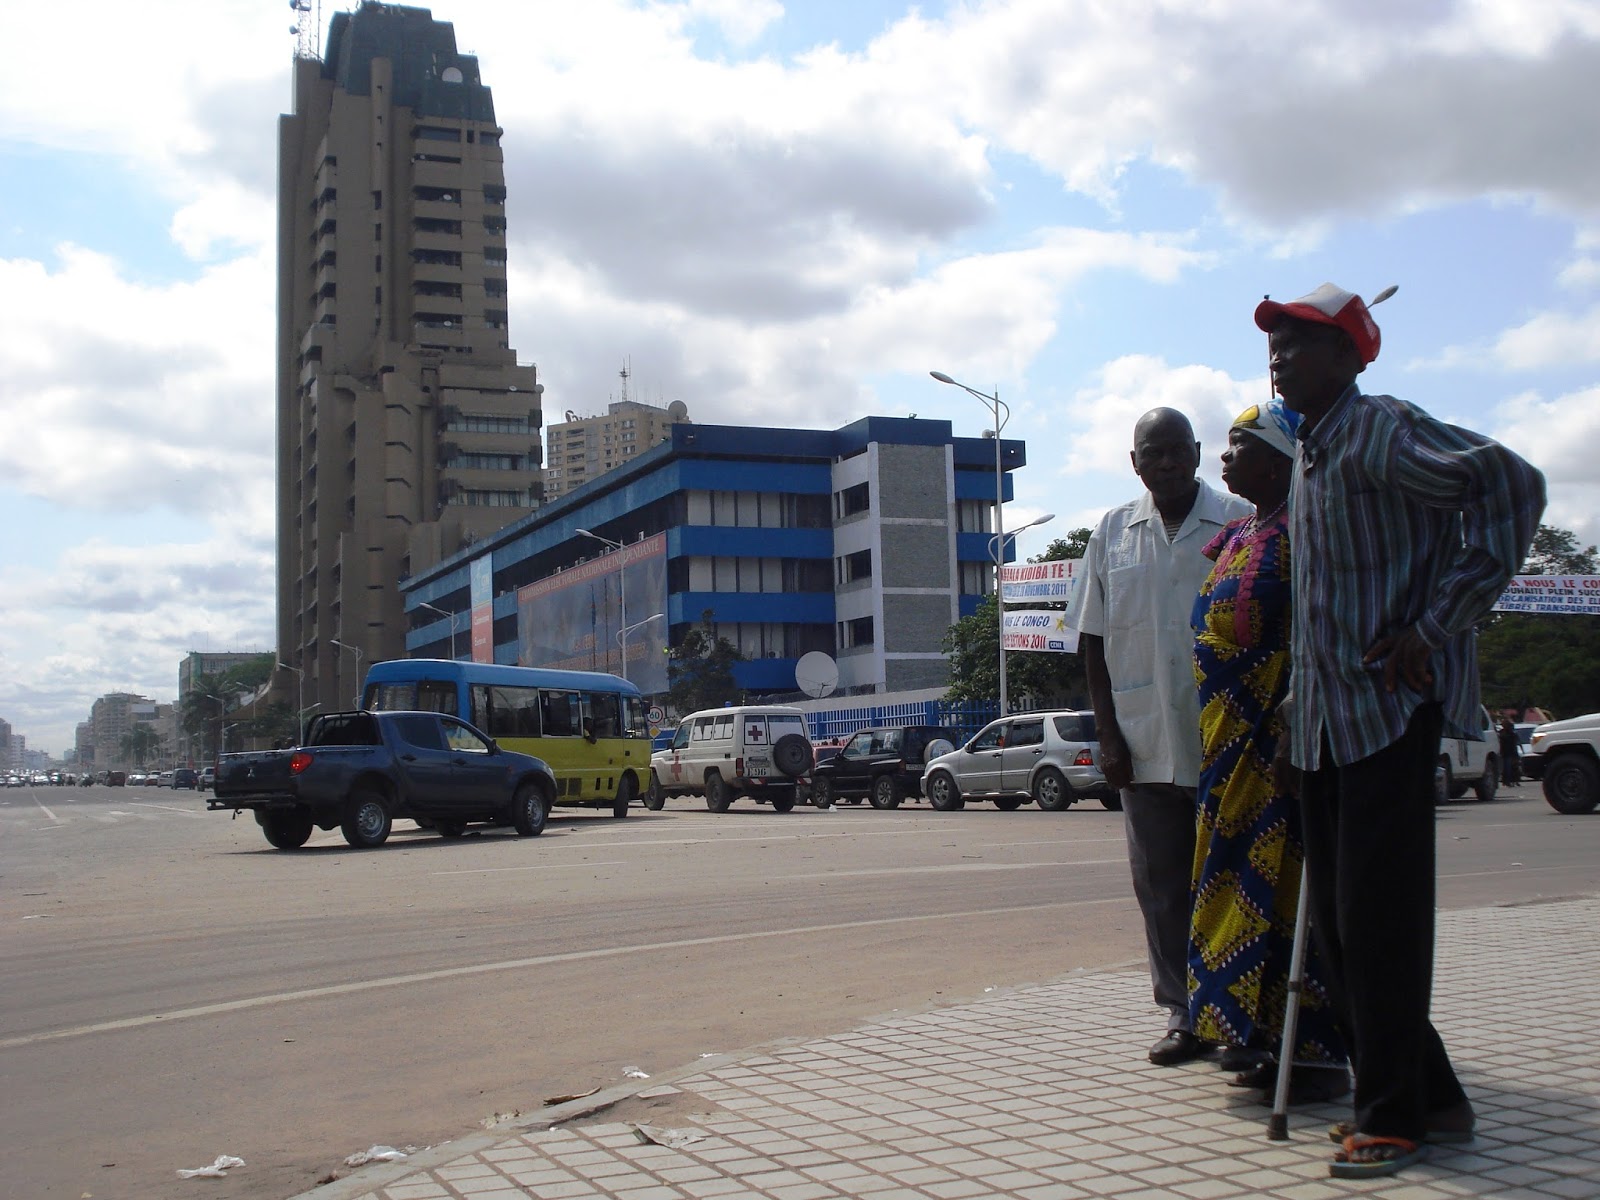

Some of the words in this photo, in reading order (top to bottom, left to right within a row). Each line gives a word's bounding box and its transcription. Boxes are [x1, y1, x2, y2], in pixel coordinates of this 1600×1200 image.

[1052, 564, 1064, 578] TE
[1523, 580, 1556, 588] NOUS
[1563, 580, 1576, 588] LE
[1051, 583, 1067, 595] 2011
[1548, 588, 1574, 596] PLEIN
[1567, 596, 1584, 604] DES
[1022, 616, 1050, 627] CONGO
[1030, 634, 1047, 649] 2011
[650, 711, 660, 719] 60
